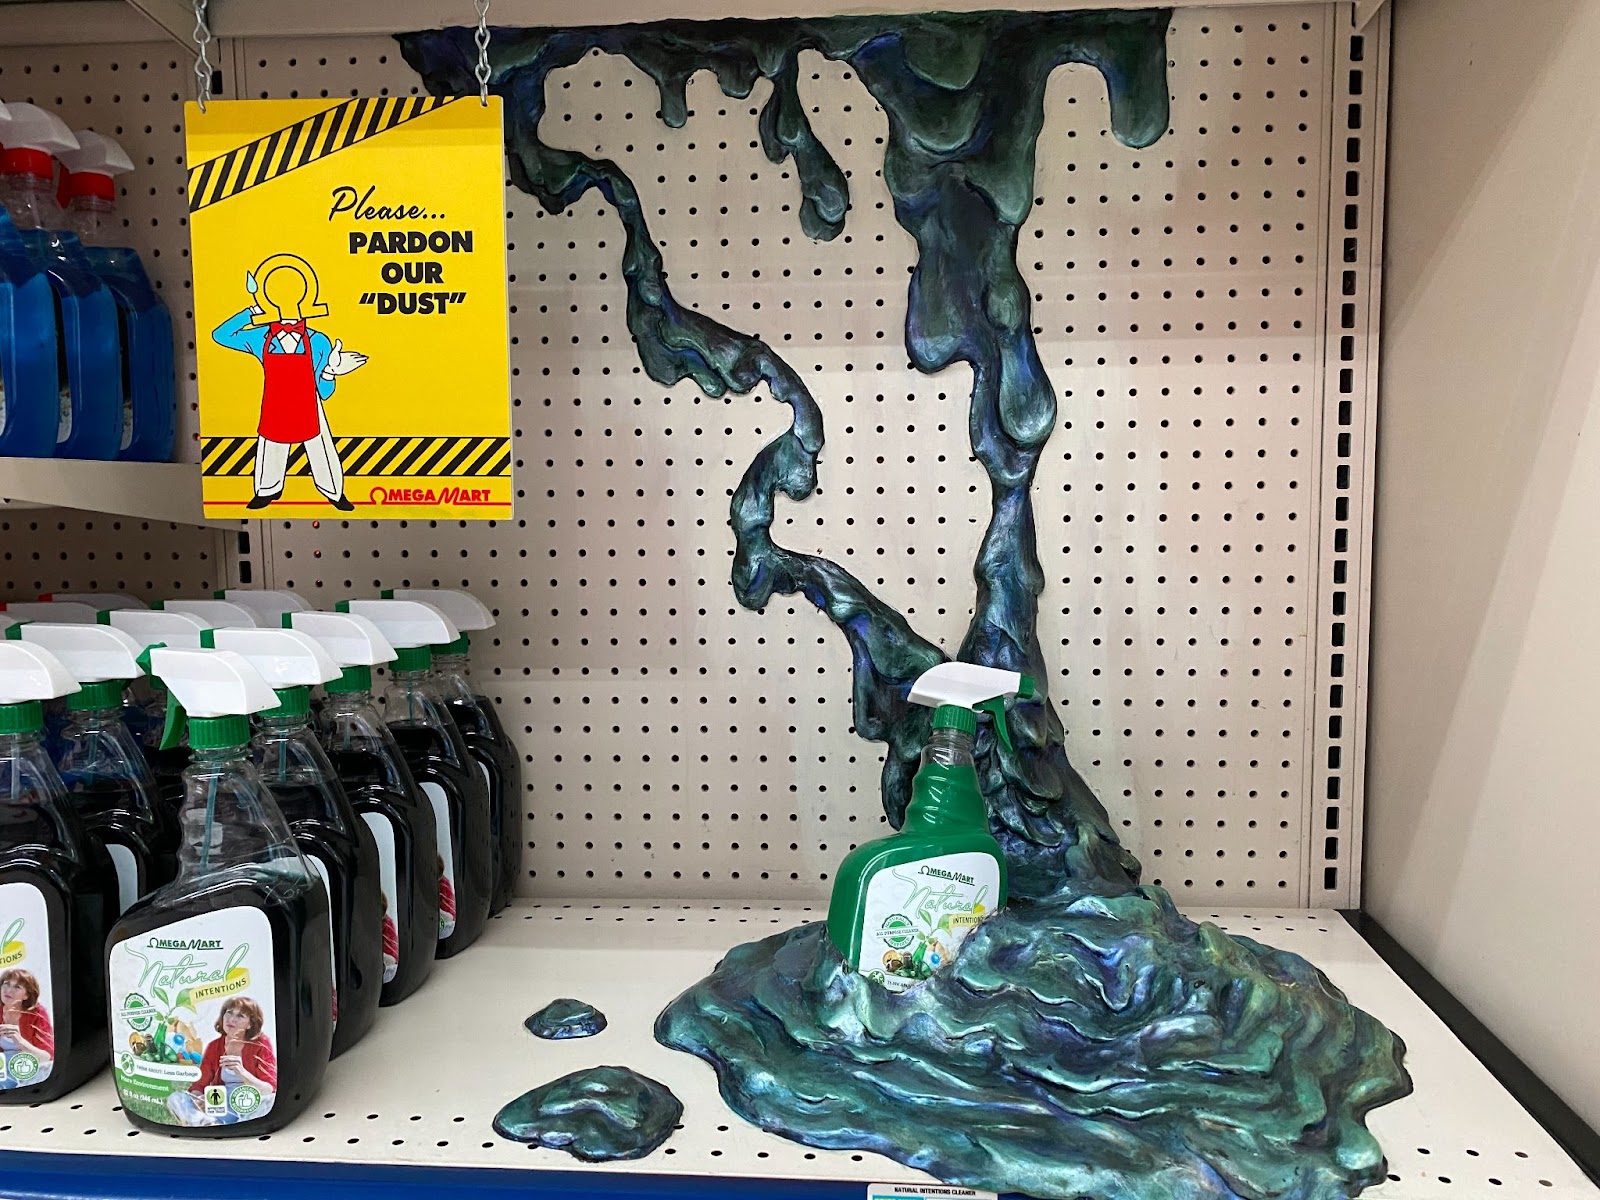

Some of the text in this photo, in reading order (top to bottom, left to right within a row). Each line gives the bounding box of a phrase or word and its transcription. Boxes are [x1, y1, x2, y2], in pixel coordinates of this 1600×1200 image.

[329, 185, 446, 221] Please...
[349, 231, 473, 254] PARDON
[380, 262, 444, 284] OUR
[358, 291, 467, 315] "DUST"
[437, 486, 491, 505] MART
[951, 872, 976, 887] MART
[892, 868, 989, 919] Natural
[187, 938, 223, 950] MART
[124, 942, 249, 998] Natural
[194, 977, 247, 999] INTENTIONS
[176, 1070, 198, 1078] Garbage
